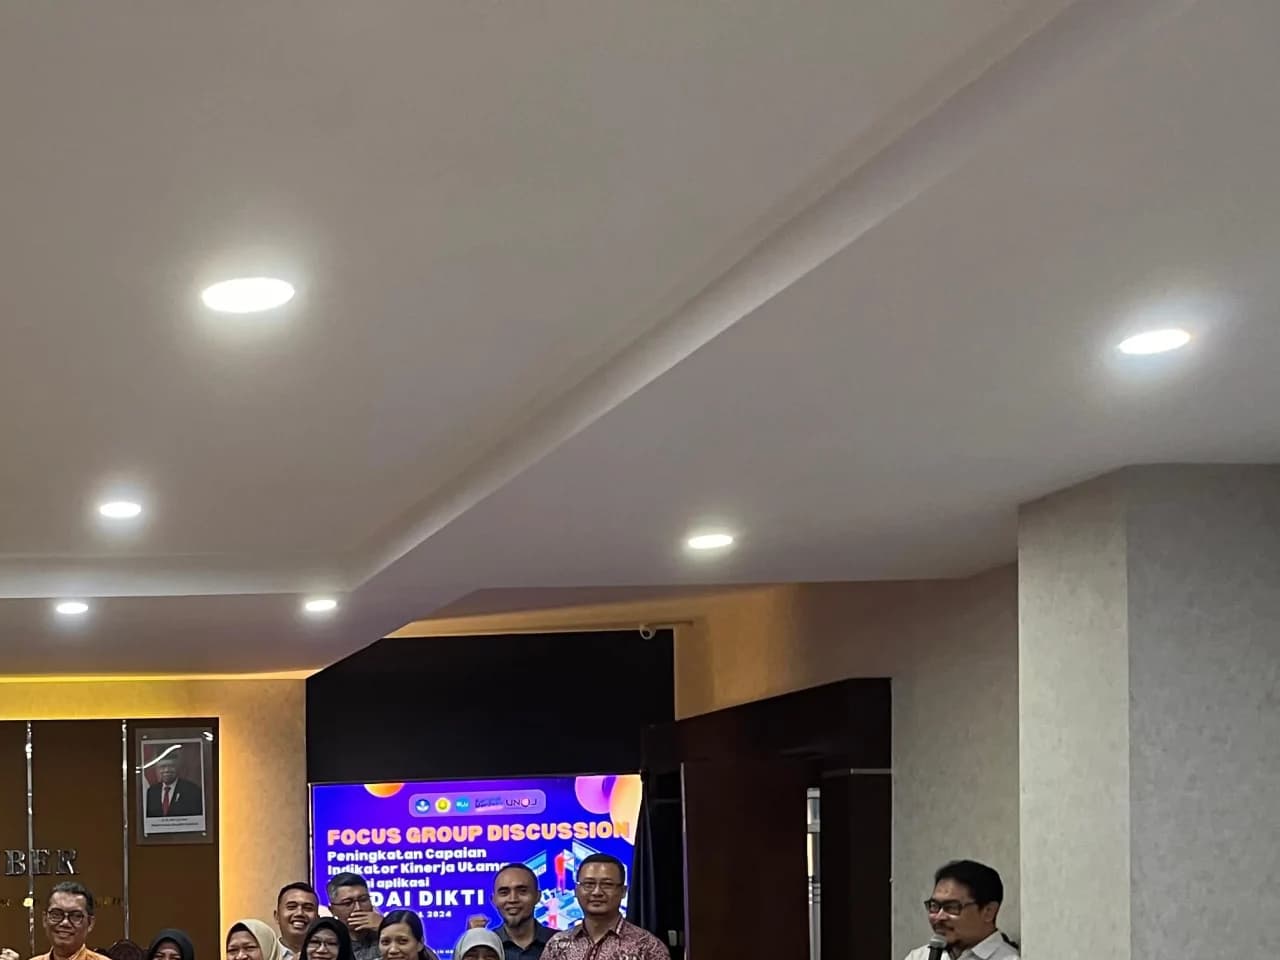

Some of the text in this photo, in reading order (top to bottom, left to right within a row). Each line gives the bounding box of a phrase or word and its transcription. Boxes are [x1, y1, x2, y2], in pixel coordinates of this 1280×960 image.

[327, 821, 630, 846] FOCUS GROUP DISCUSSION
[327, 847, 487, 863] Peningkatan Capaian
[327, 863, 398, 875] Indikator
[400, 862, 455, 875] Kinerja
[376, 877, 430, 889] aplikasi
[419, 889, 485, 907] DIKTI
